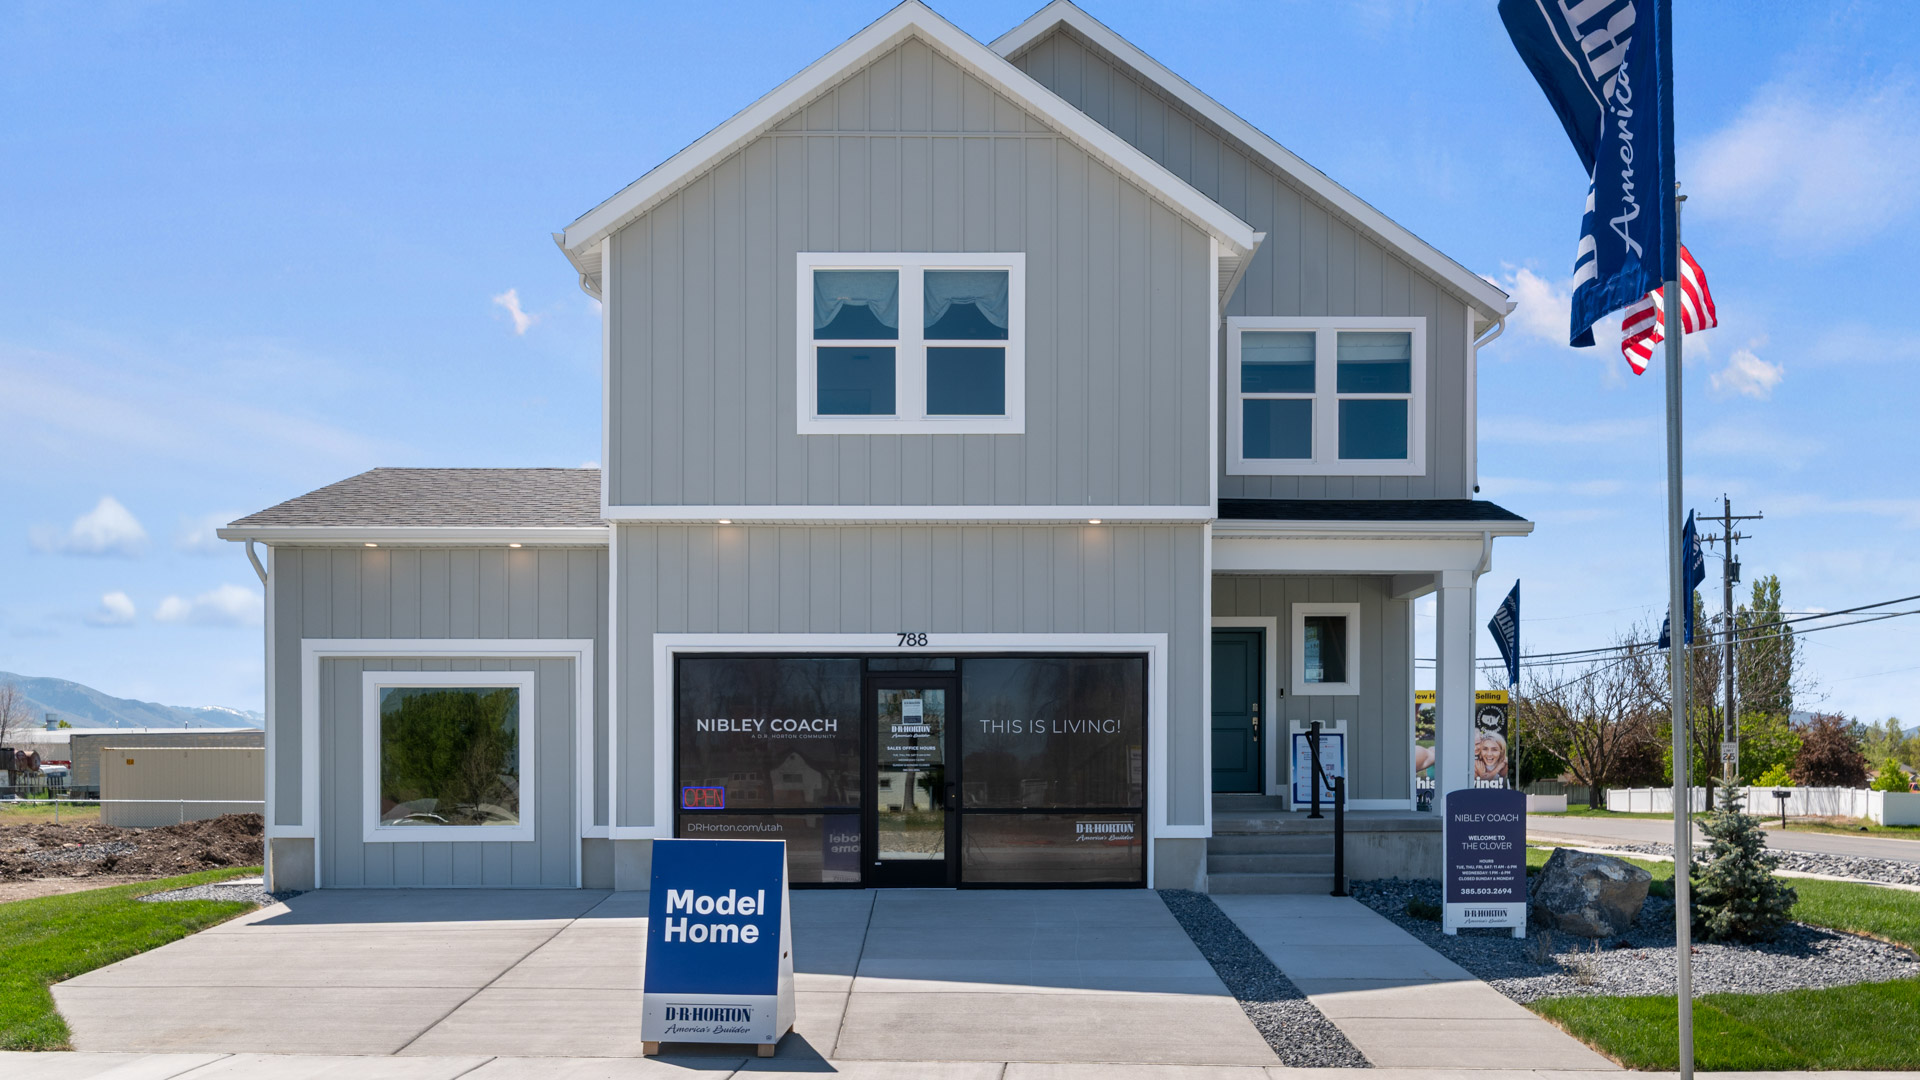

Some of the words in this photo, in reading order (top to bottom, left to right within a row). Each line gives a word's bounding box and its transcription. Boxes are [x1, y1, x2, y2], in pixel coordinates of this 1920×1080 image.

[896, 632, 928, 647] 788
[1475, 692, 1501, 700] Selling
[696, 718, 765, 732] NIBLEY
[770, 718, 838, 732] COACH
[979, 719, 1023, 734] THIS
[1029, 719, 1046, 734] IS
[1052, 719, 1121, 734] LIVING!
[1723, 752, 1736, 760] 25
[1416, 776, 1436, 789] his
[684, 788, 723, 807] OPEN
[1454, 813, 1486, 822] NIBLEY
[1486, 813, 1519, 822] COACH
[687, 823, 783, 833] DRHorton.com/utah
[1462, 842, 1478, 850] THE
[1479, 842, 1512, 850] CLOVER
[666, 889, 765, 915] Model
[664, 917, 760, 943] Home
[664, 1023, 711, 1034] America's
[713, 1023, 750, 1034] Builder
